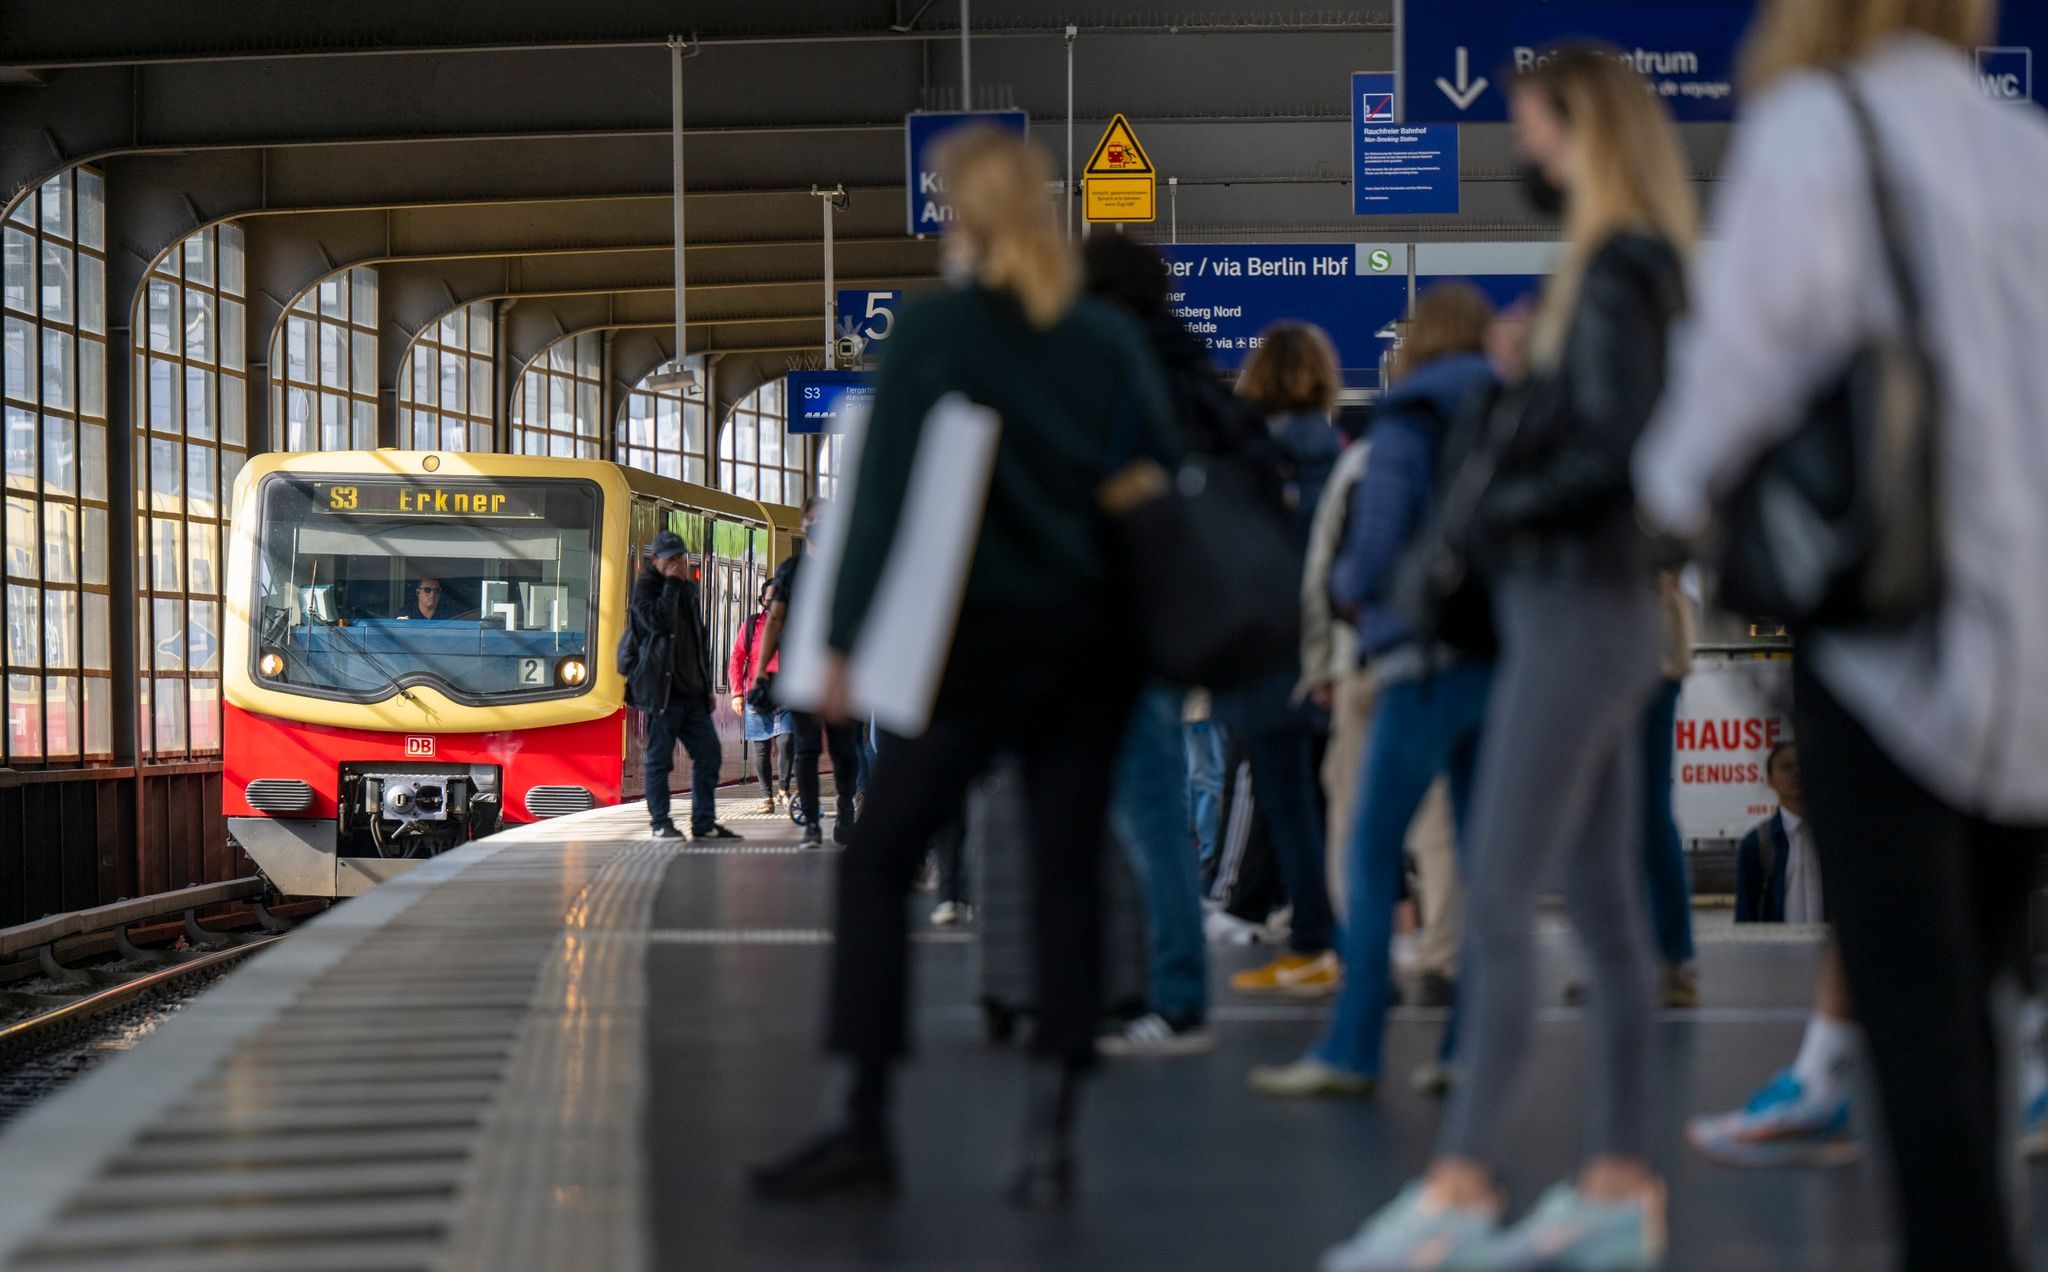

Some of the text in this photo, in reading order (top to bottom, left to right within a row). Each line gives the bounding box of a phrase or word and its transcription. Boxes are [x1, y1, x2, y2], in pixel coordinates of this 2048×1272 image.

[1980, 73, 2019, 97] WC
[1363, 127, 1427, 136] Rauchfreier Bahnhof
[1161, 256, 1348, 277] ber / via Berlin Hbf
[1370, 250, 1390, 271] S
[1166, 291, 1186, 302] ner
[864, 291, 895, 340] 5
[1171, 306, 1242, 320] usberg Nord
[1216, 337, 1233, 349] via
[804, 387, 821, 399] S3
[330, 486, 506, 513] S3 Erkner
[524, 659, 538, 682] 2
[1675, 718, 1781, 751] HAUSE
[409, 738, 432, 753] DB
[1681, 763, 1765, 785] GENUSS.
